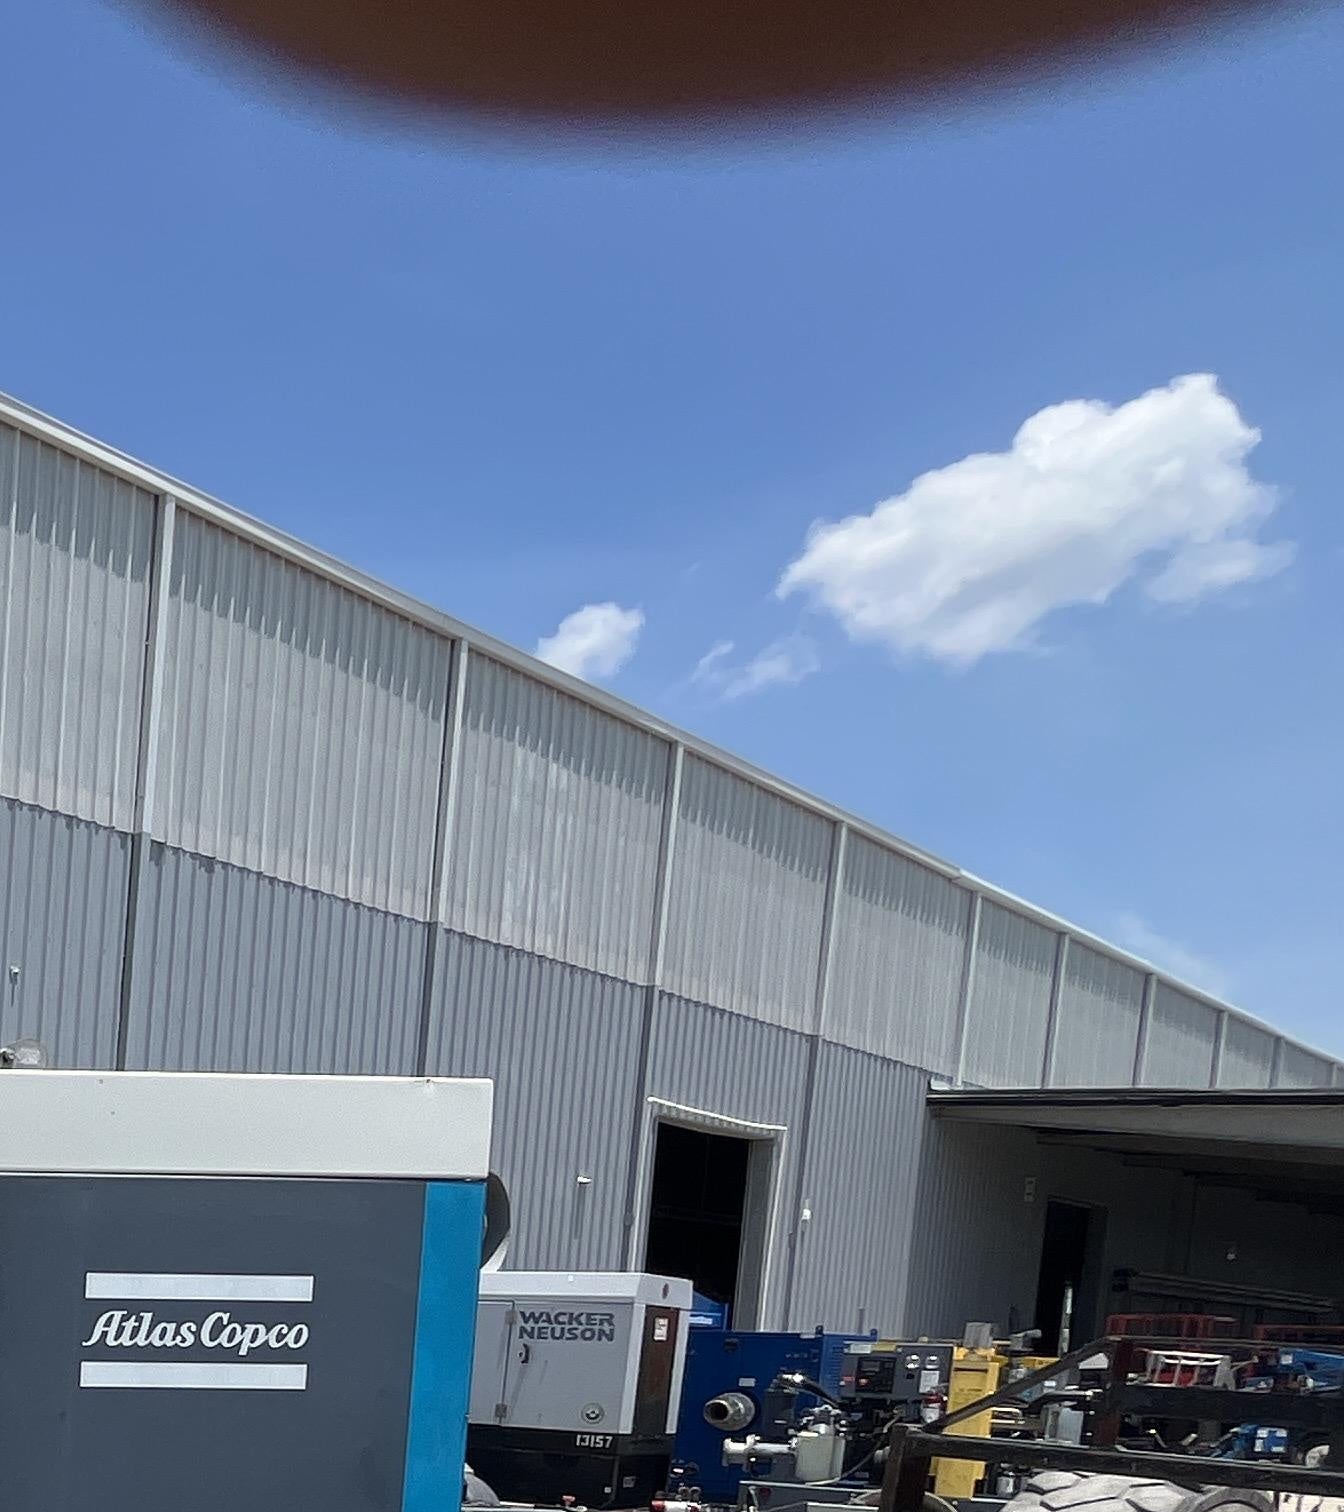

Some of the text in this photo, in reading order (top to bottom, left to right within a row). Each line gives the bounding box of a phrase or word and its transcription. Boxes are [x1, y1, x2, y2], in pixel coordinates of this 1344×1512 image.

[519, 1310, 616, 1327] WACKER
[81, 1309, 310, 1356] Atlas Copco
[518, 1326, 615, 1342] NEUSON
[575, 1434, 614, 1449] 13157
